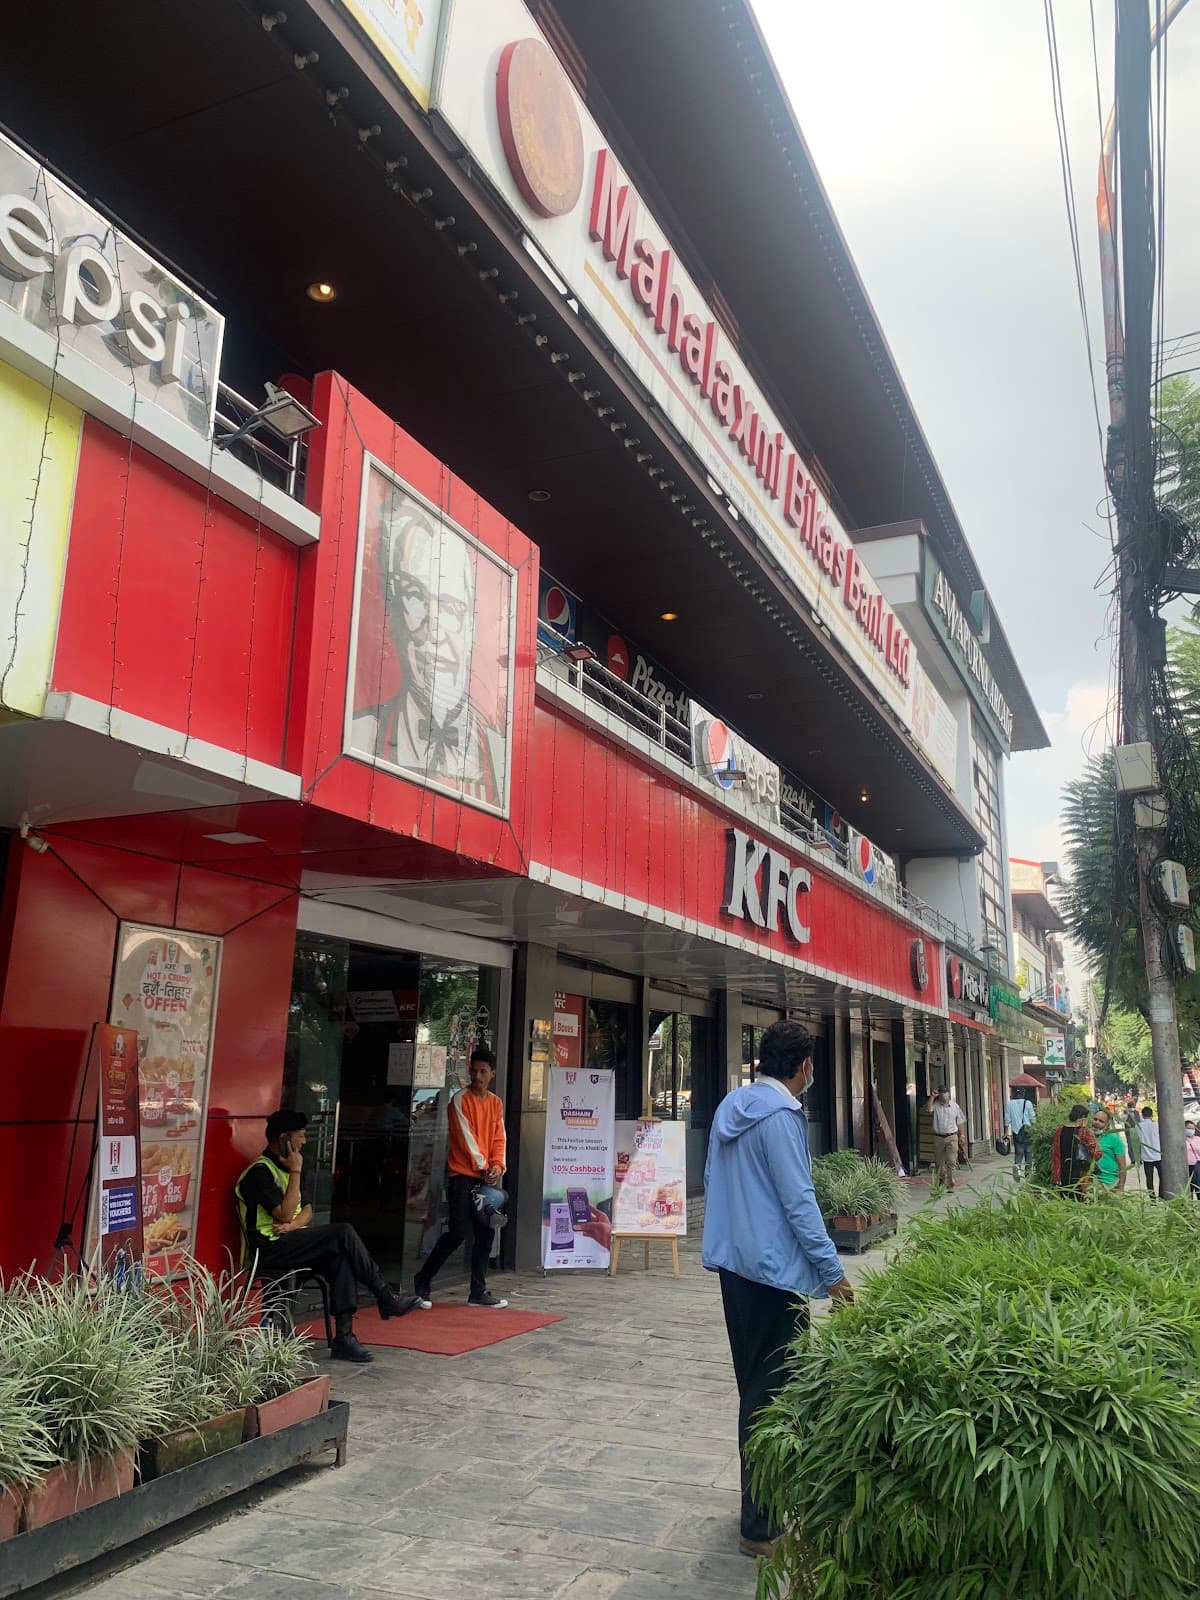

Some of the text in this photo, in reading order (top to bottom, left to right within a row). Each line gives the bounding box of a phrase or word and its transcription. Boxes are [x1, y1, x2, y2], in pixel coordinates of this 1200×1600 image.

[0, 194, 191, 384] epsi
[589, 149, 784, 500] Mahalaxmi
[784, 453, 845, 588] Bikas
[843, 548, 884, 653] Bank
[631, 654, 675, 709] Pizza
[720, 827, 813, 944] KFC
[144, 995, 187, 1012] OFFER
[400, 1003, 416, 1011] KFC
[1046, 1040, 1053, 1051] P
[143, 1205, 158, 1218] SPY
